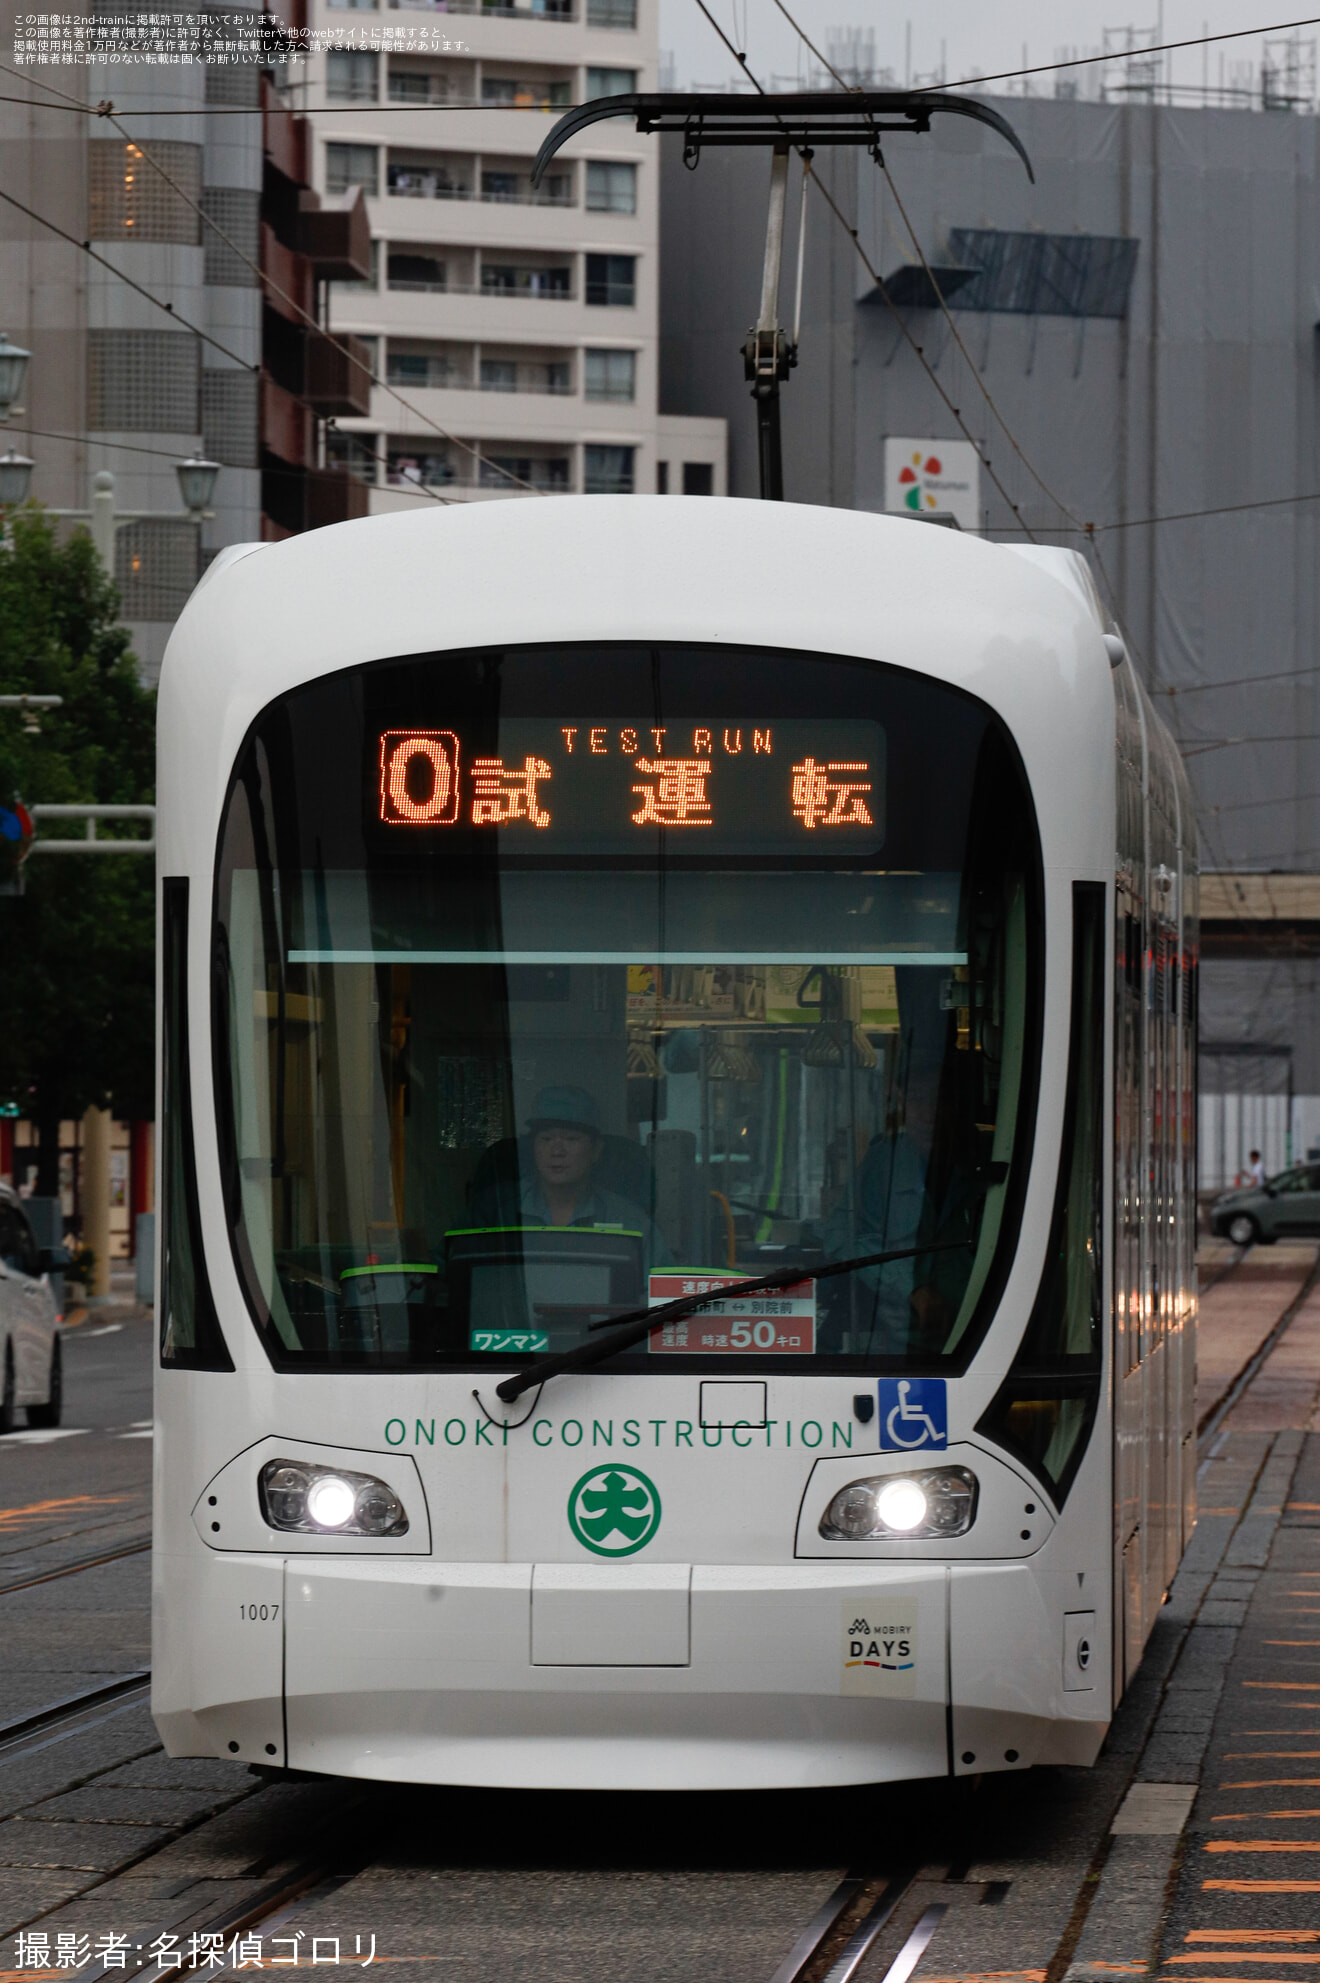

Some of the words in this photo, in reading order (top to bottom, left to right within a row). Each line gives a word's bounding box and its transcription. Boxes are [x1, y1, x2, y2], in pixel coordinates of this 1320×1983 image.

[562, 728, 666, 753] TEST
[694, 729, 772, 754] RUN
[474, 1333, 549, 1351] ワンマン
[384, 1418, 508, 1446] ONOKI
[532, 1419, 853, 1449] CONSTRUCTION
[240, 1604, 280, 1621] 1007
[873, 1625, 912, 1635] MOBIRY
[850, 1640, 911, 1657] DAYS
